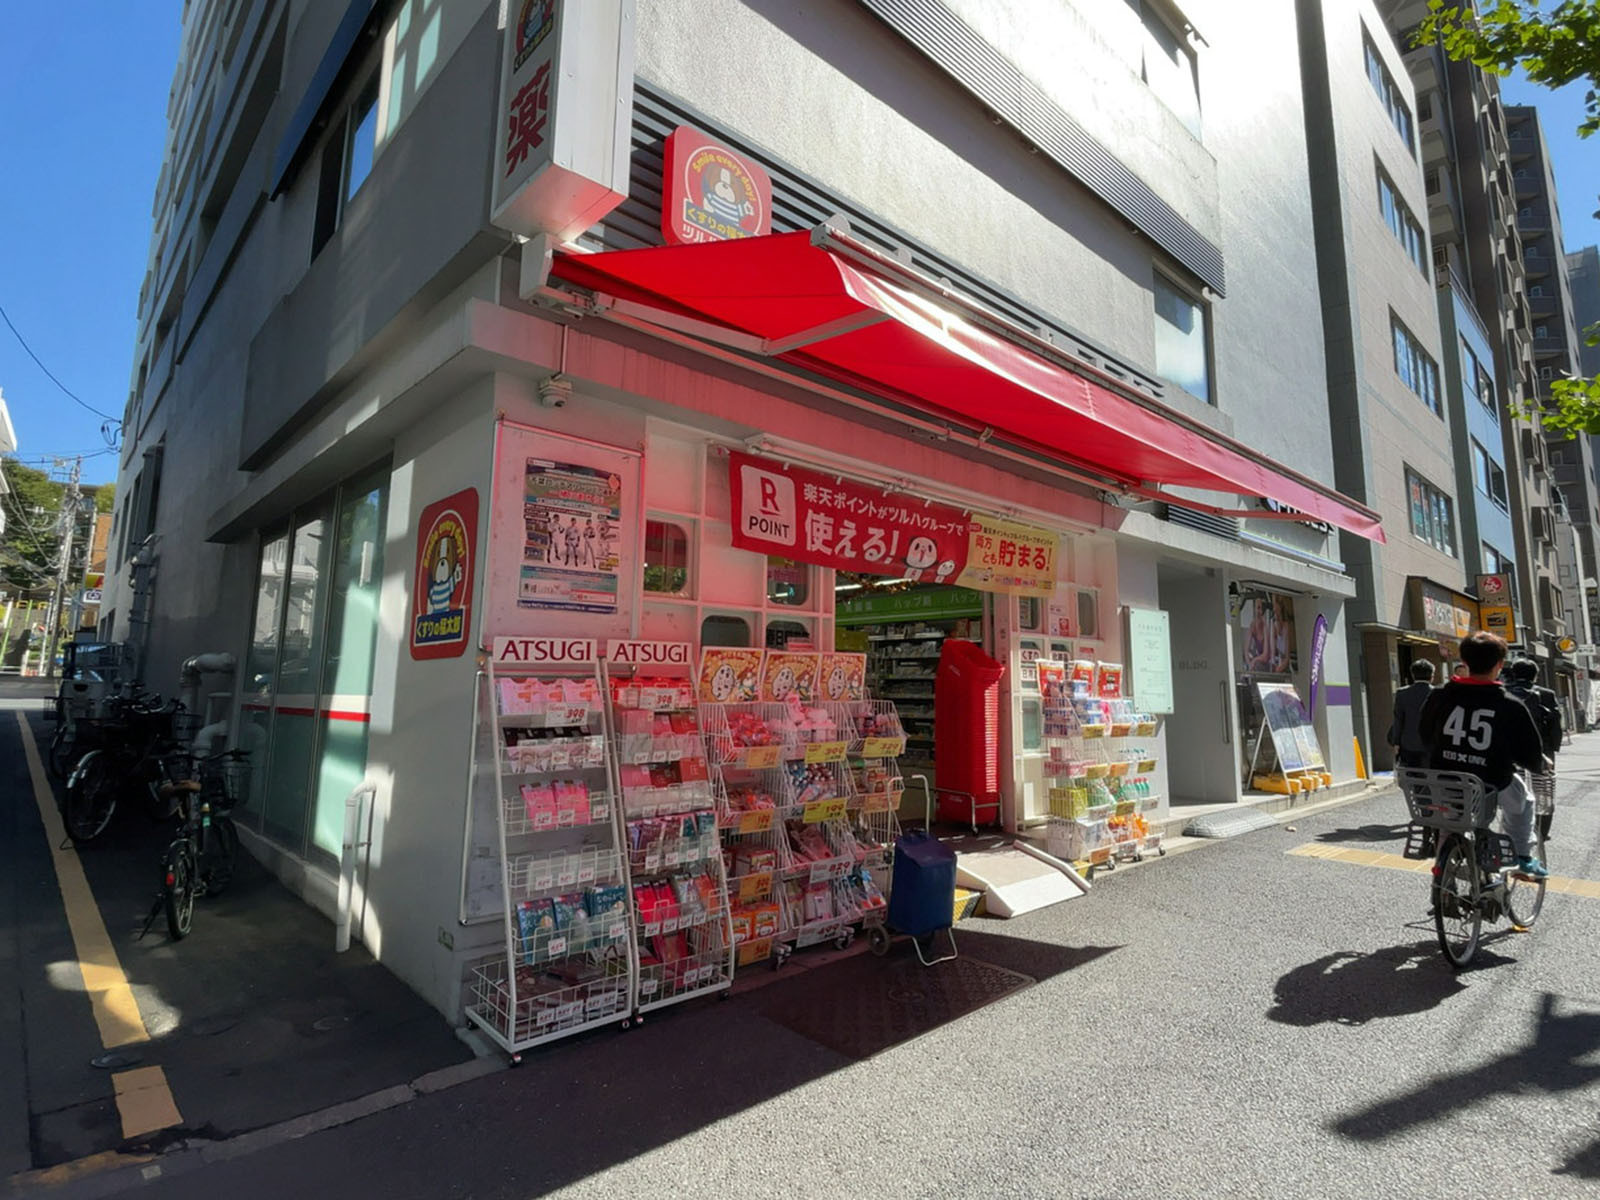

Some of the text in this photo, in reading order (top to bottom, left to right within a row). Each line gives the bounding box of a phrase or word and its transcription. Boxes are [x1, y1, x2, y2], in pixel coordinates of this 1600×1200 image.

[506, 60, 551, 178] 薬
[760, 476, 780, 515] R
[803, 482, 965, 536] 楽天ポイントがツルハグループで
[749, 516, 791, 541] POINT
[982, 551, 998, 565] とも
[500, 640, 591, 661] ATSUGI
[611, 643, 688, 663] ATSUGI
[565, 708, 585, 719] 398
[1443, 705, 1495, 751] 45
